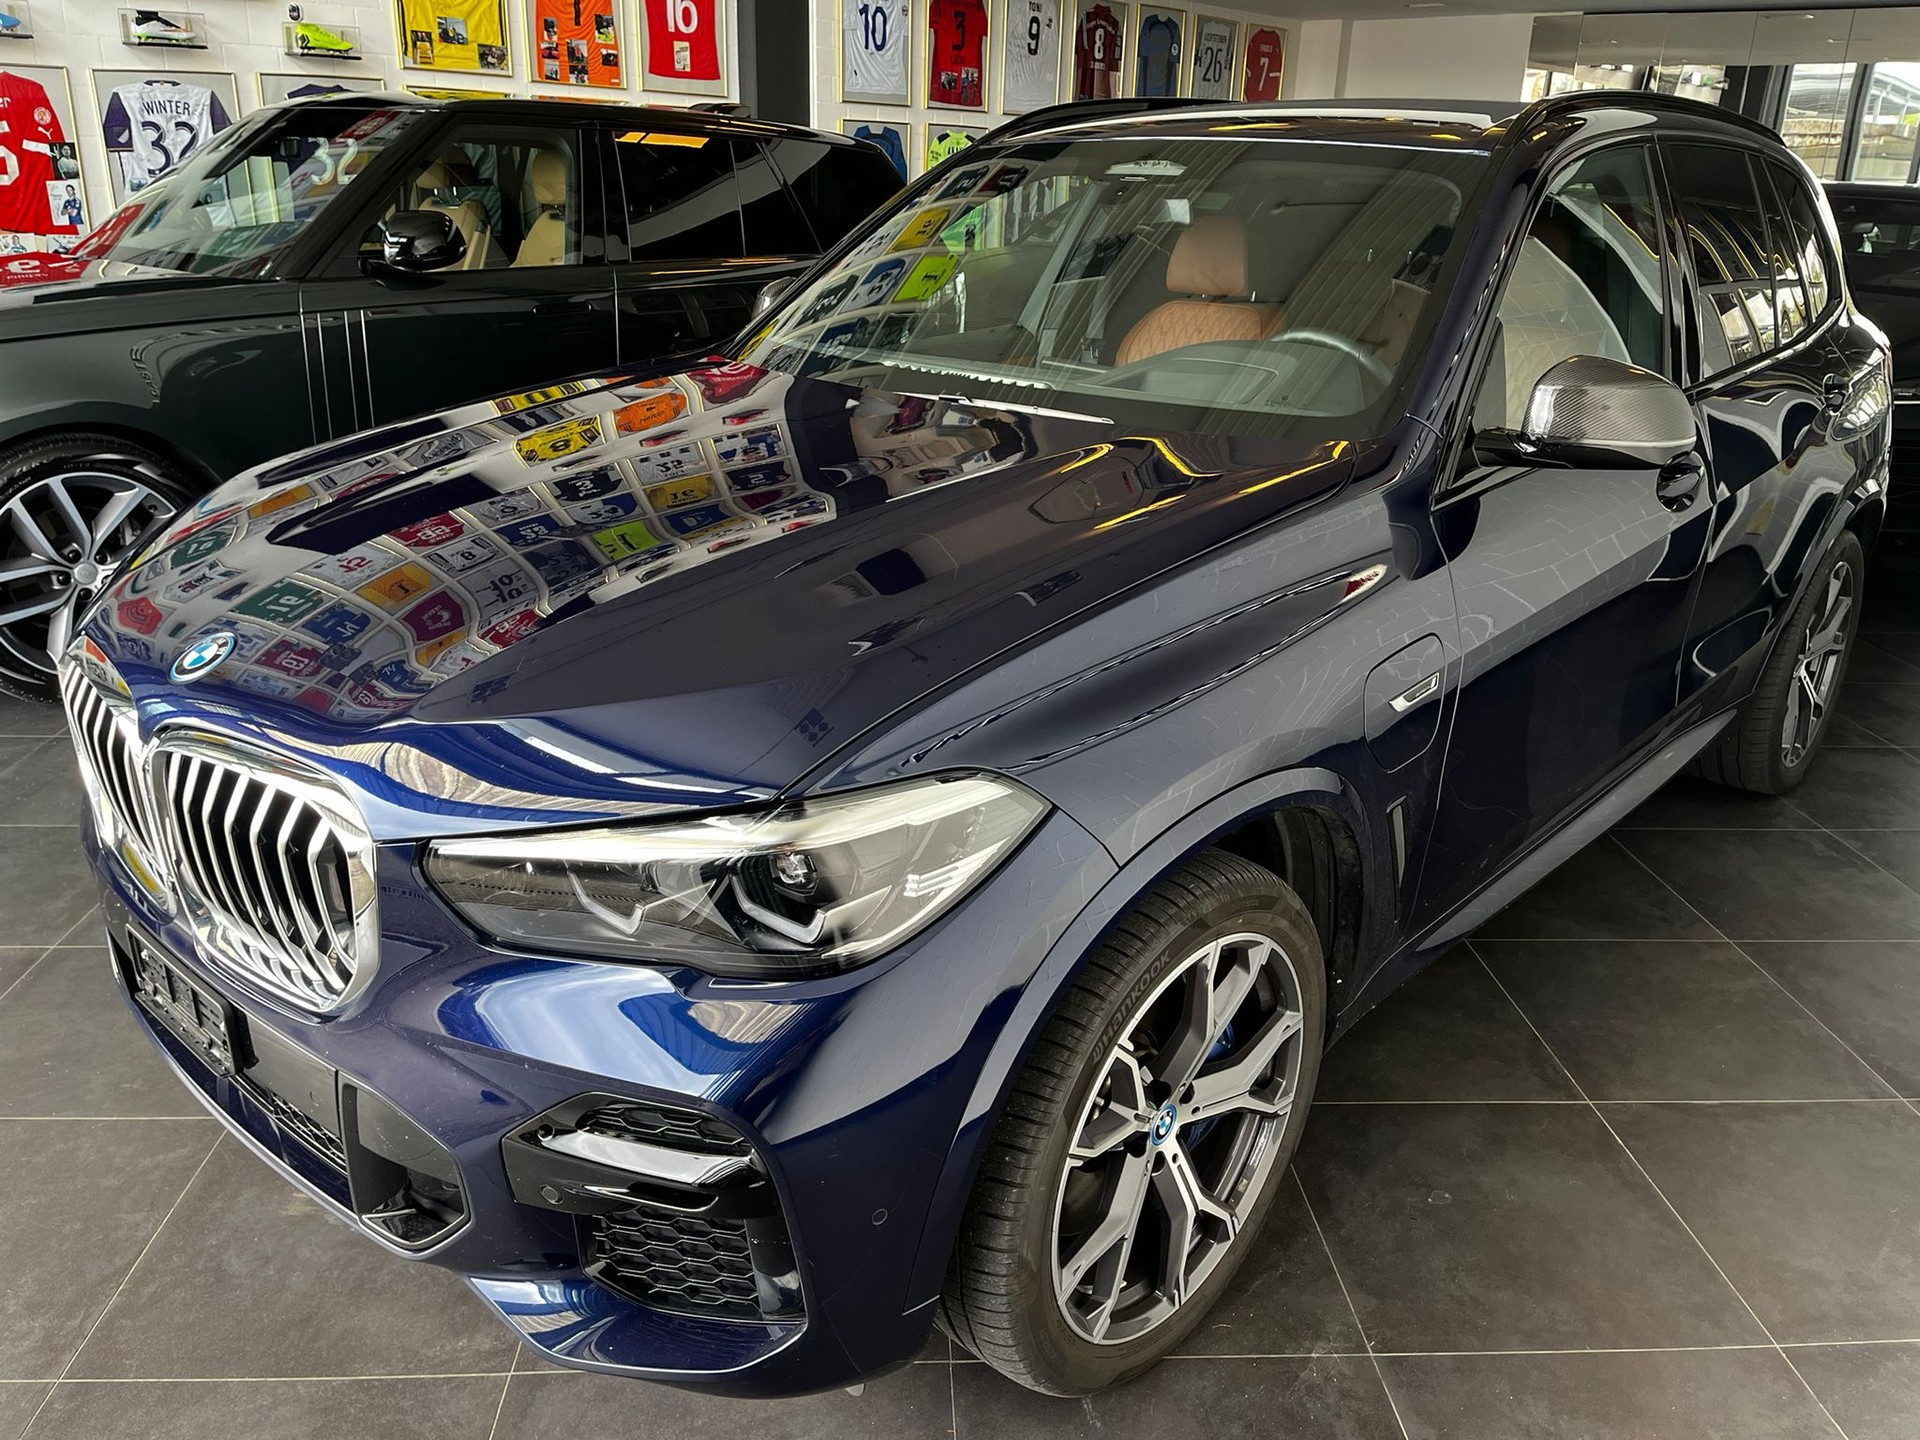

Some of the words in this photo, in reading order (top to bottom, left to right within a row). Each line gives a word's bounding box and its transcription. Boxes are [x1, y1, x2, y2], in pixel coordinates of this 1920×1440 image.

[666, 0, 699, 34] 16
[858, 3, 888, 52] 10
[952, 11, 966, 51] 3
[1027, 15, 1041, 56] 9
[1094, 28, 1105, 59] 8
[1202, 47, 1223, 83] 26
[1258, 57, 1269, 92] 7
[142, 99, 191, 116] WINTER
[307, 137, 358, 185] 32
